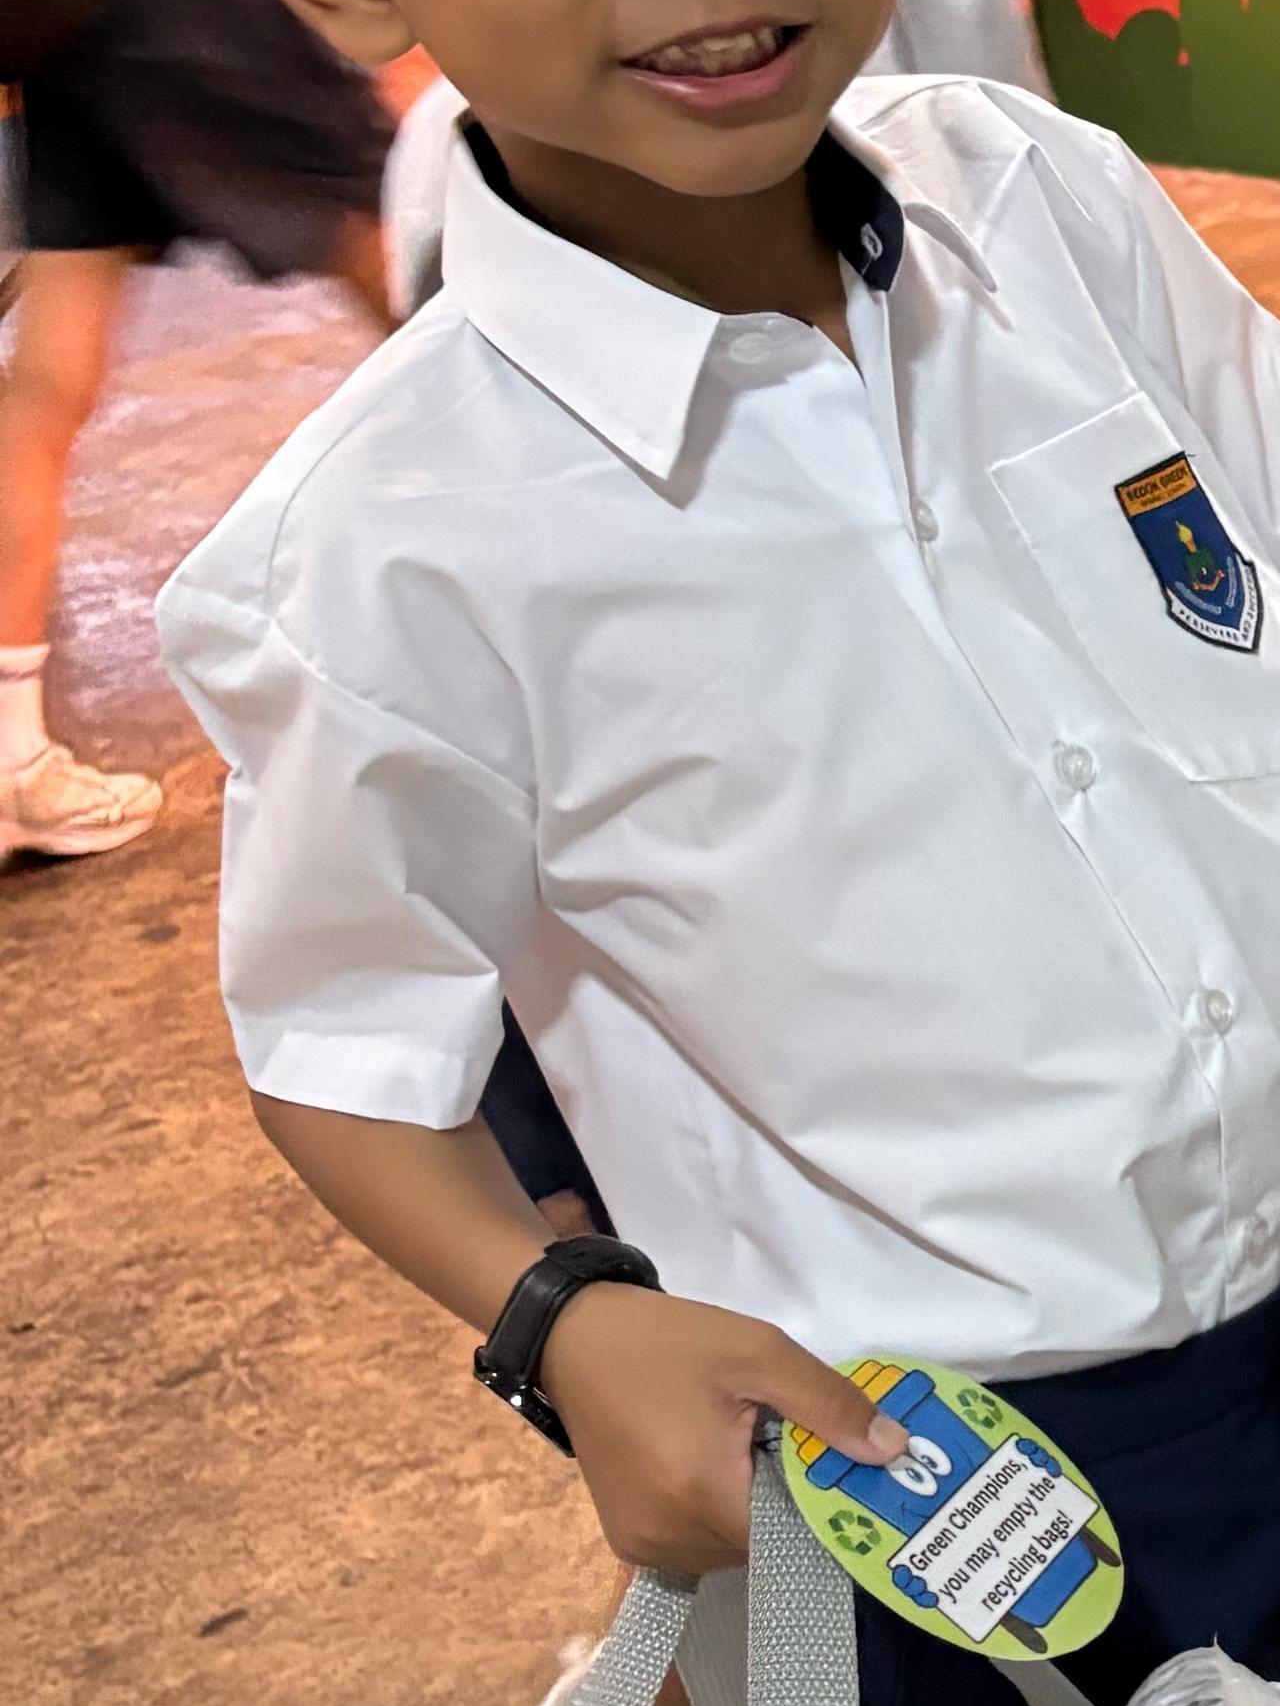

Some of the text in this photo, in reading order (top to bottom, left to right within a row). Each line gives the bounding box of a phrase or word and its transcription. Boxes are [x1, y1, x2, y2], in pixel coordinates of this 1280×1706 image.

[908, 1458, 1029, 1573] Green Champions,
[937, 1476, 1057, 1606] you may empty the
[980, 1510, 1075, 1613] recycling bags!
